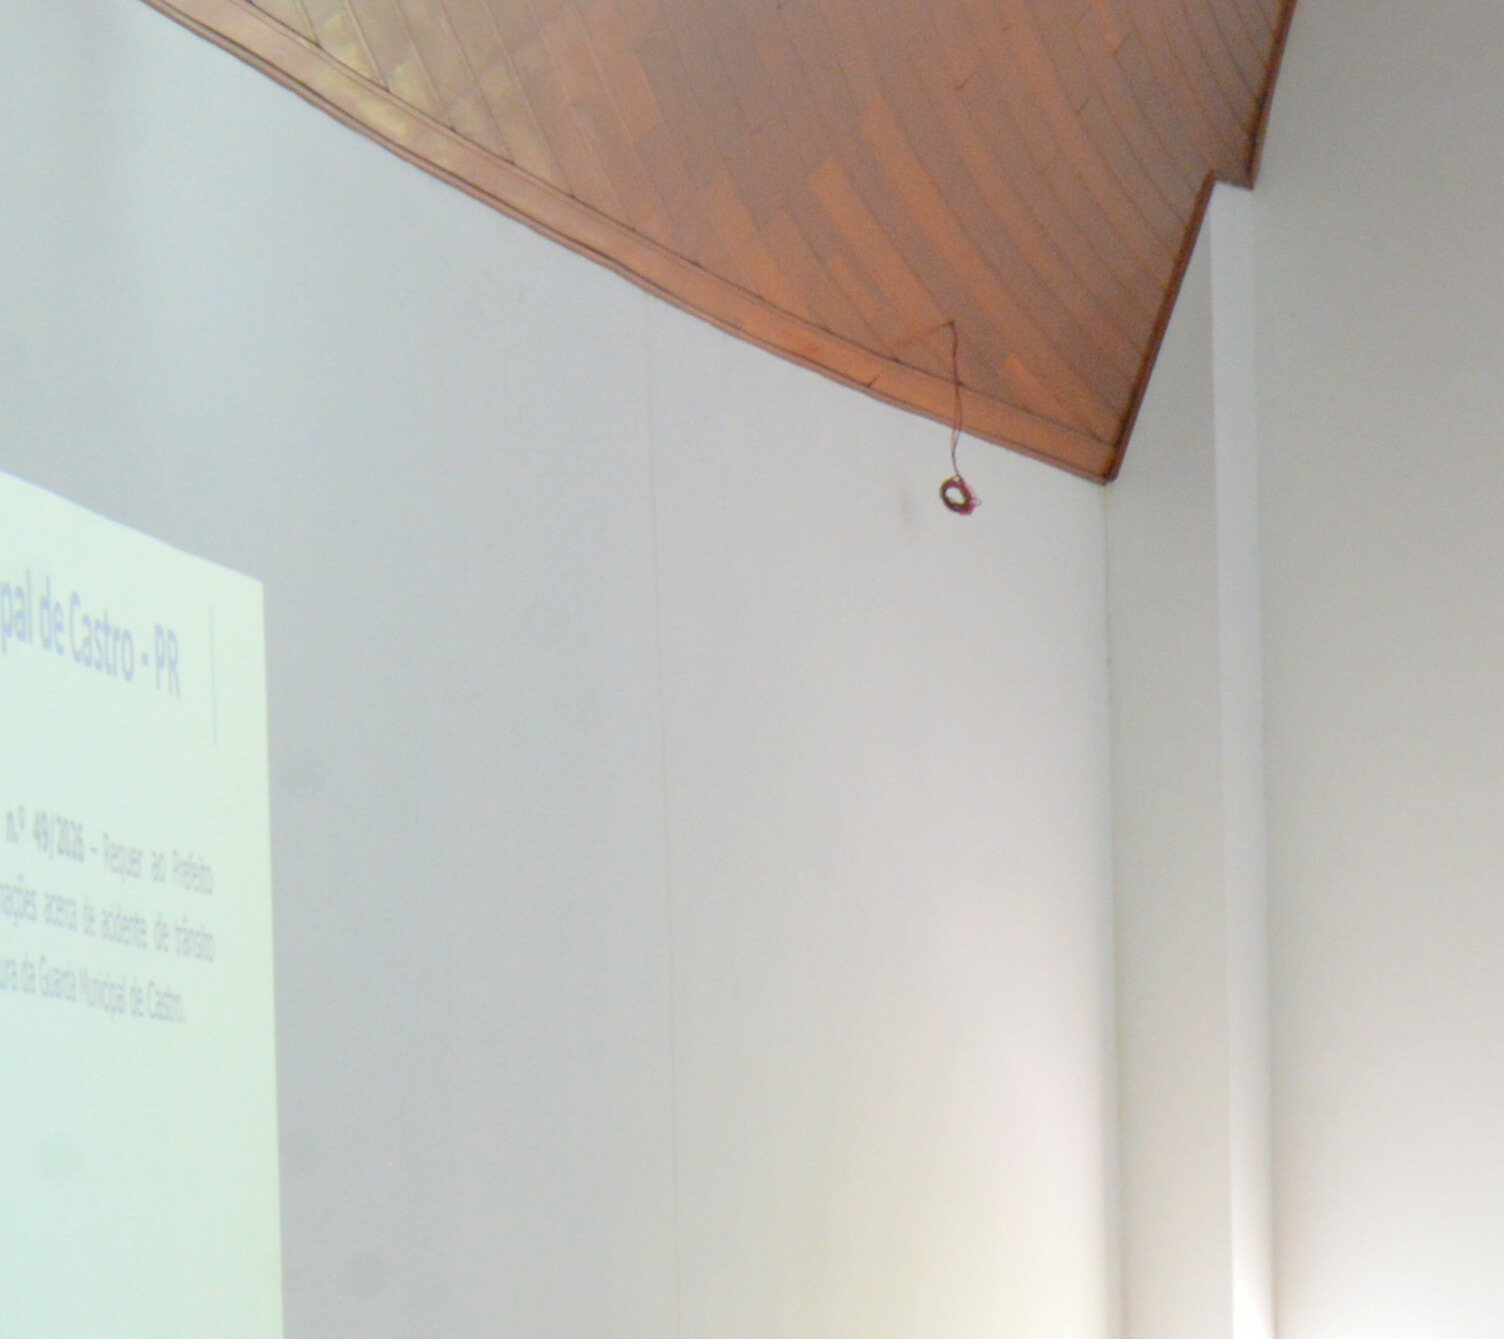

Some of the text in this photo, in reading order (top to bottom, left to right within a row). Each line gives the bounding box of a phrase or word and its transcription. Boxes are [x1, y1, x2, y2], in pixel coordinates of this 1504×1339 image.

[39, 575, 65, 657] de
[69, 590, 135, 683] Castro
[154, 622, 182, 699] PR
[154, 911, 170, 953] de
[130, 974, 145, 1018] de
